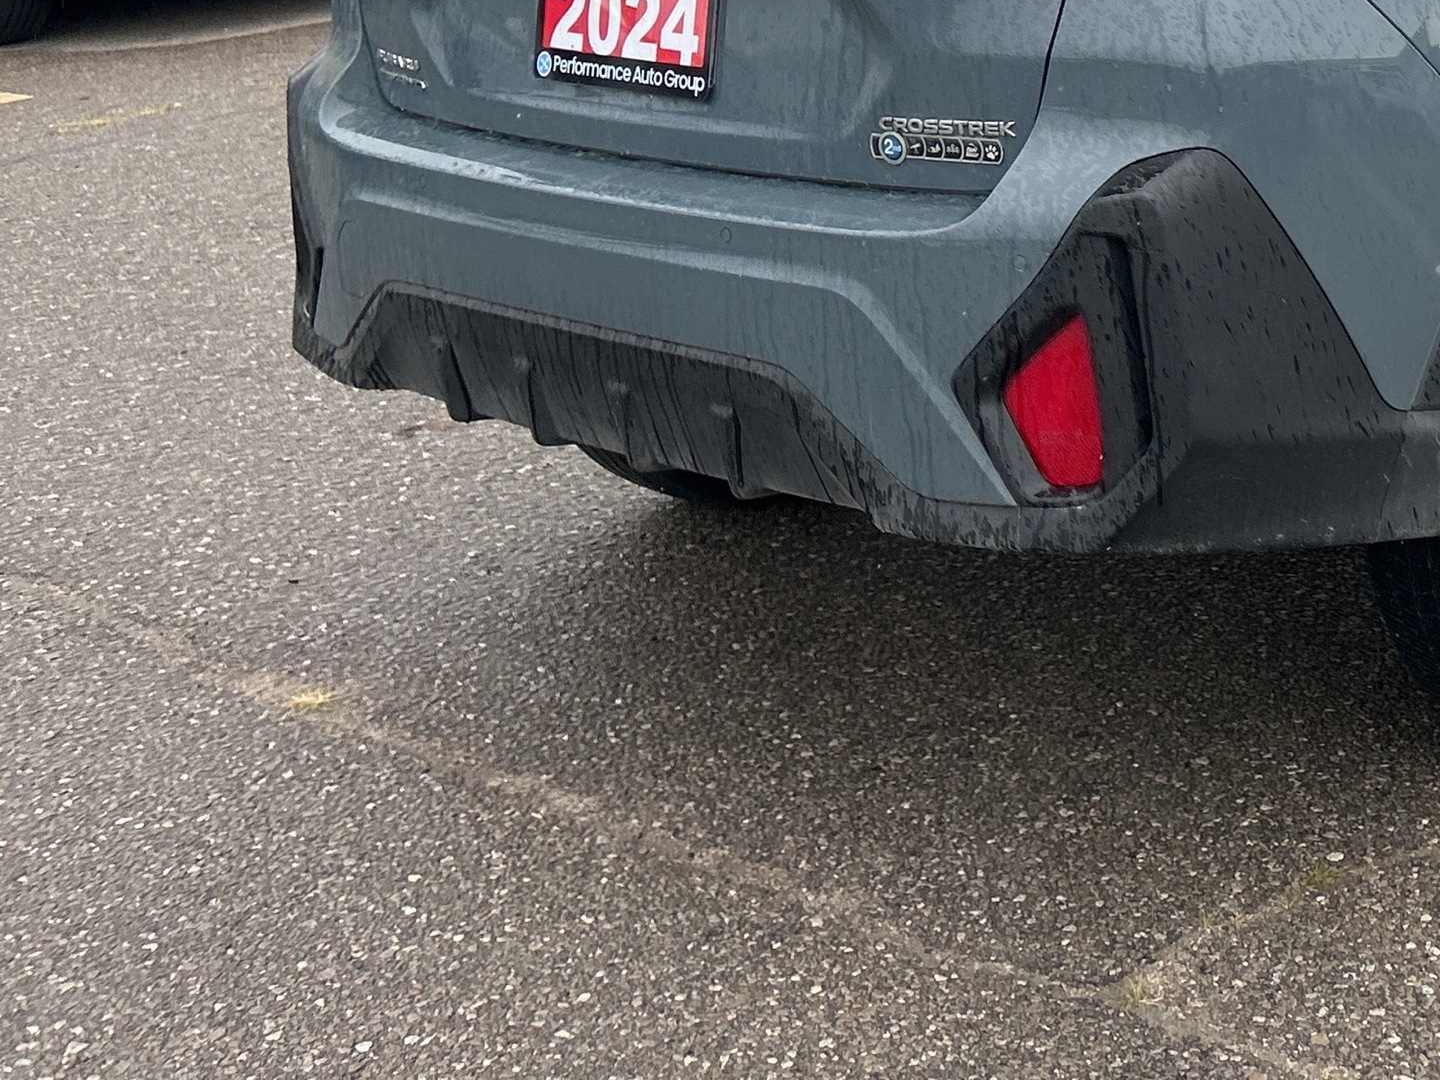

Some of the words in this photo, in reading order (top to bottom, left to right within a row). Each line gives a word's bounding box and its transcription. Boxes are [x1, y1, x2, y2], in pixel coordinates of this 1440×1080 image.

[552, 55, 631, 83] Performance
[632, 65, 663, 87] Auto
[664, 69, 705, 97] Group
[878, 116, 1016, 138] CROSSTREK
